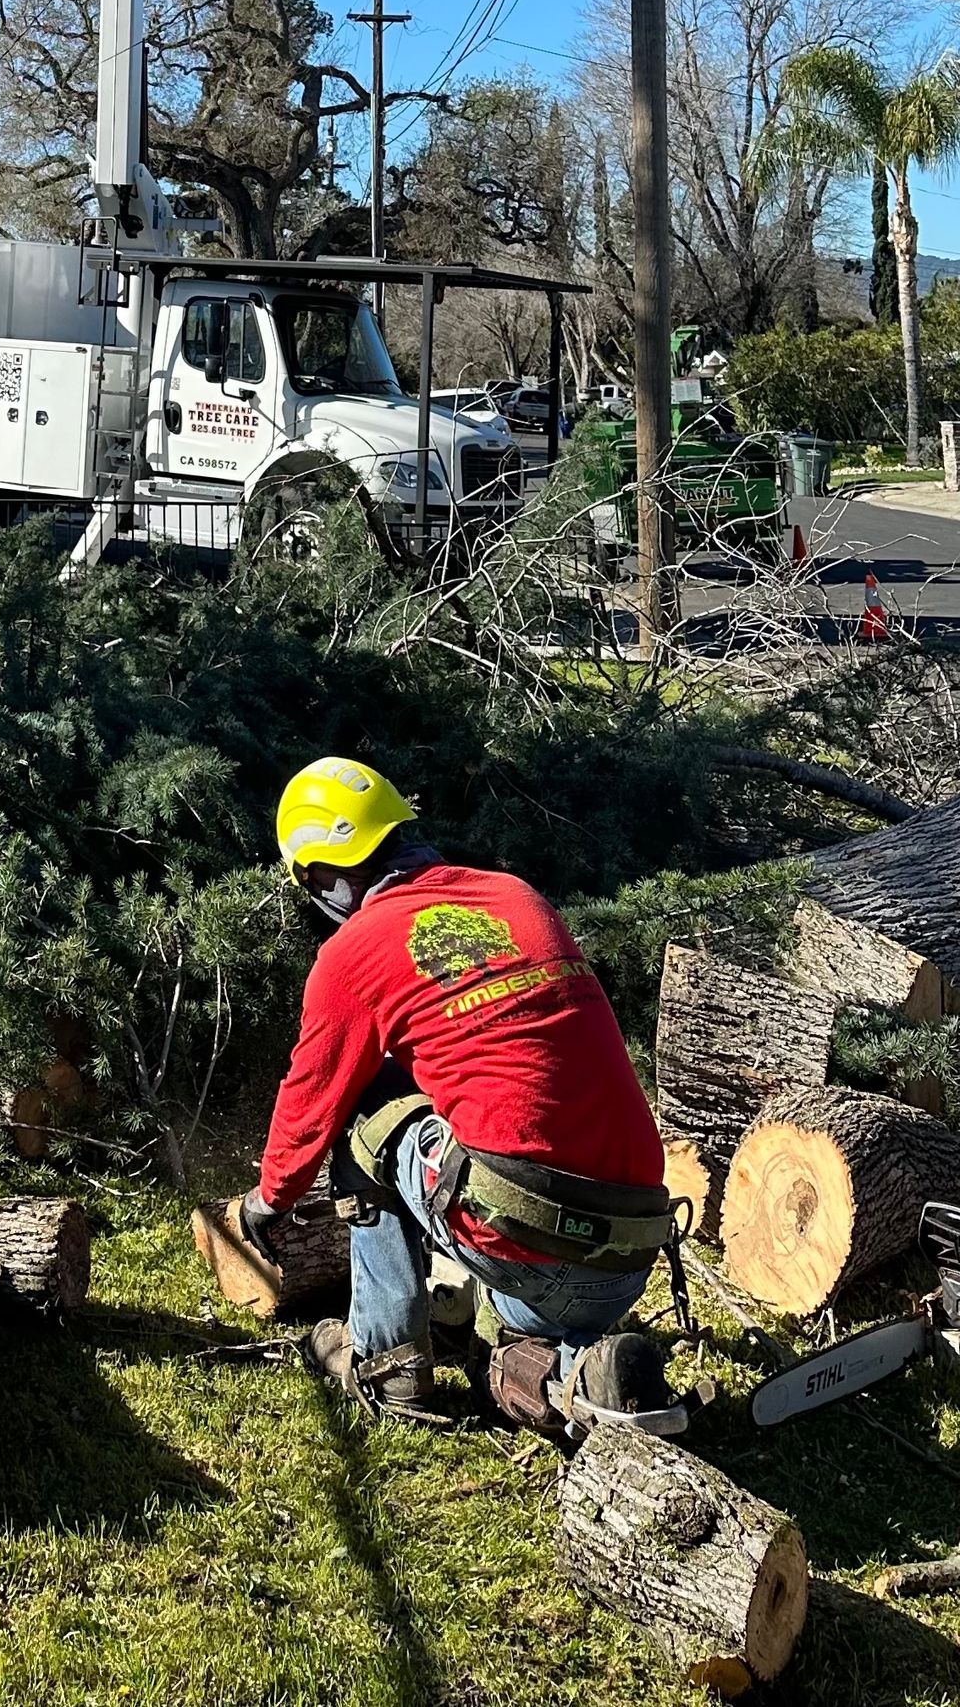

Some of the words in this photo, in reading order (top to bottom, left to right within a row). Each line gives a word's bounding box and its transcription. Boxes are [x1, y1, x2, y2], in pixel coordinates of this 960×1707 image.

[195, 402, 252, 414] TIMBERLAND
[188, 410, 222, 423] TREE
[226, 413, 259, 427] CARE
[180, 455, 195, 466] CA
[198, 457, 237, 471] 598572
[443, 961, 593, 1018] TIMBERLAN
[805, 1361, 845, 1397] STIHL
